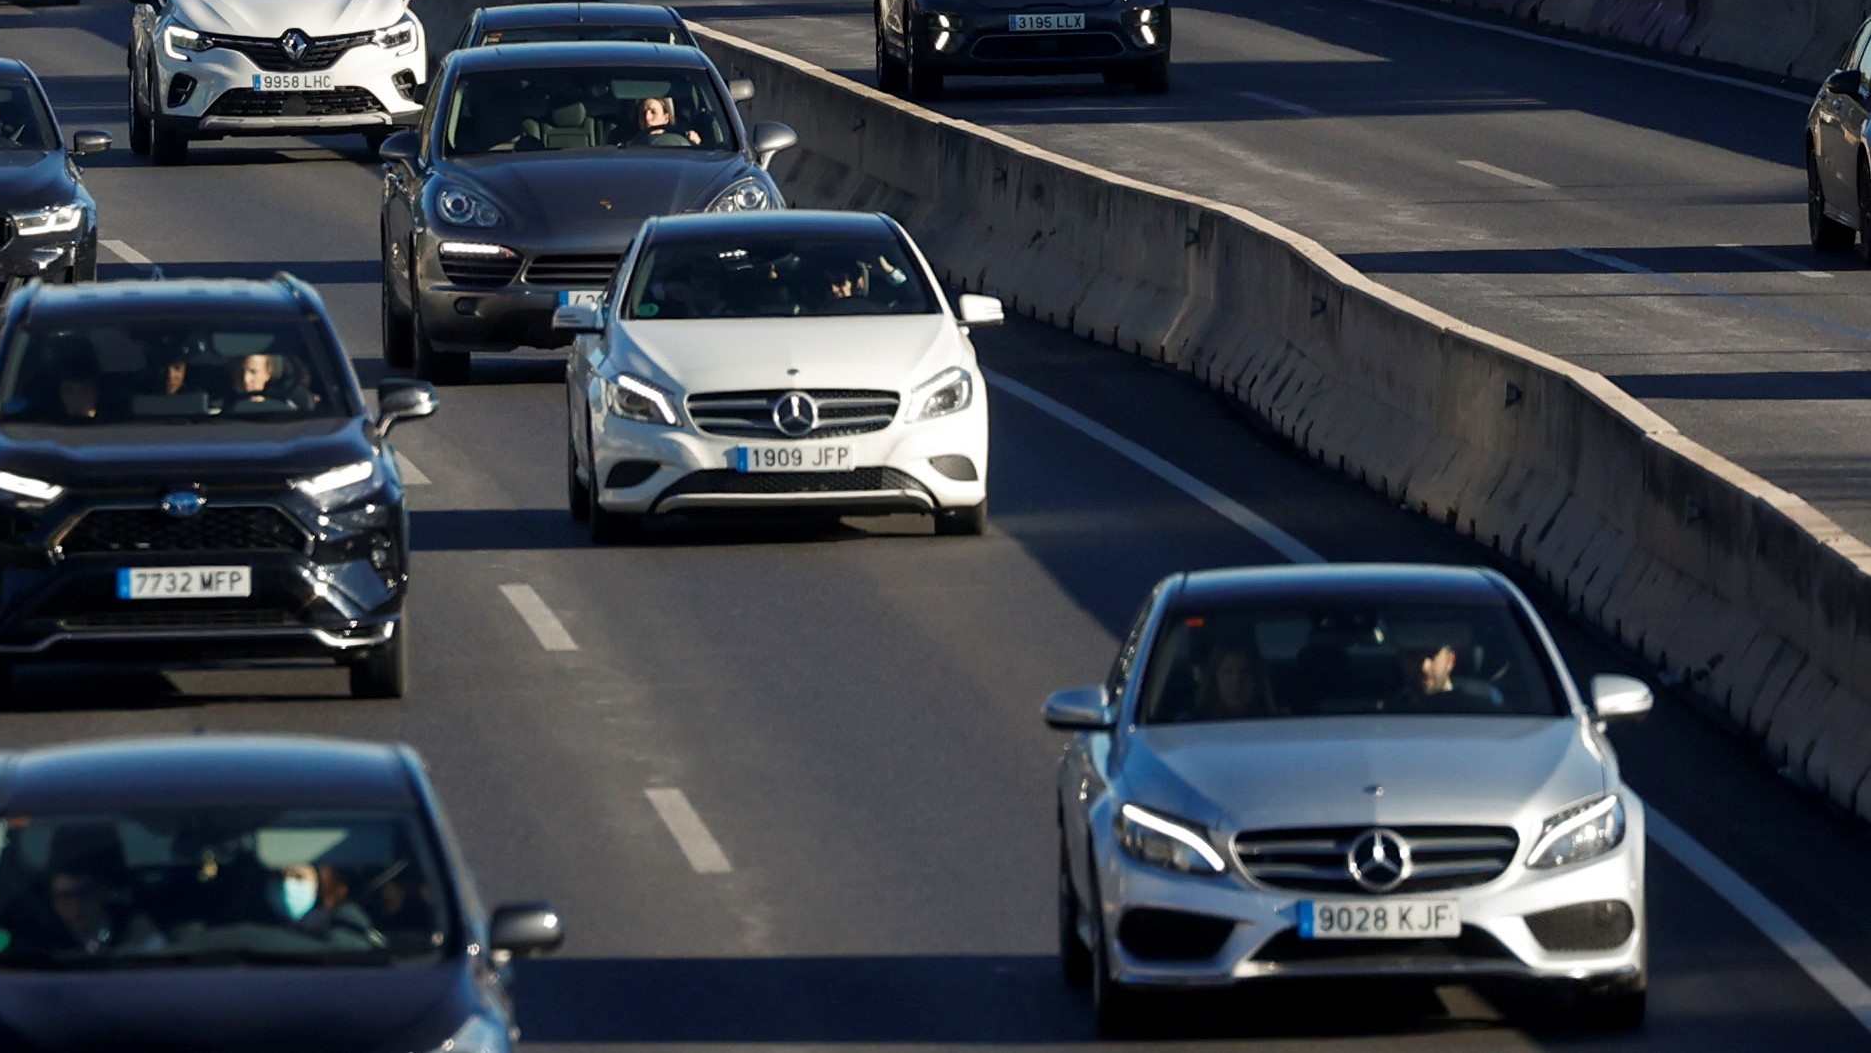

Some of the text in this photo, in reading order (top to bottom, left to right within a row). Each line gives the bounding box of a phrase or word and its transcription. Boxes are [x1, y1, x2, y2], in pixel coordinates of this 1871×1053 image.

[1018, 16, 1082, 29] 3195 LLX
[264, 75, 331, 88] 9958 LHC
[754, 449, 848, 468] 1909 JFP
[136, 572, 243, 593] 7732 MFP
[1319, 905, 1449, 931] 9028 KJF
